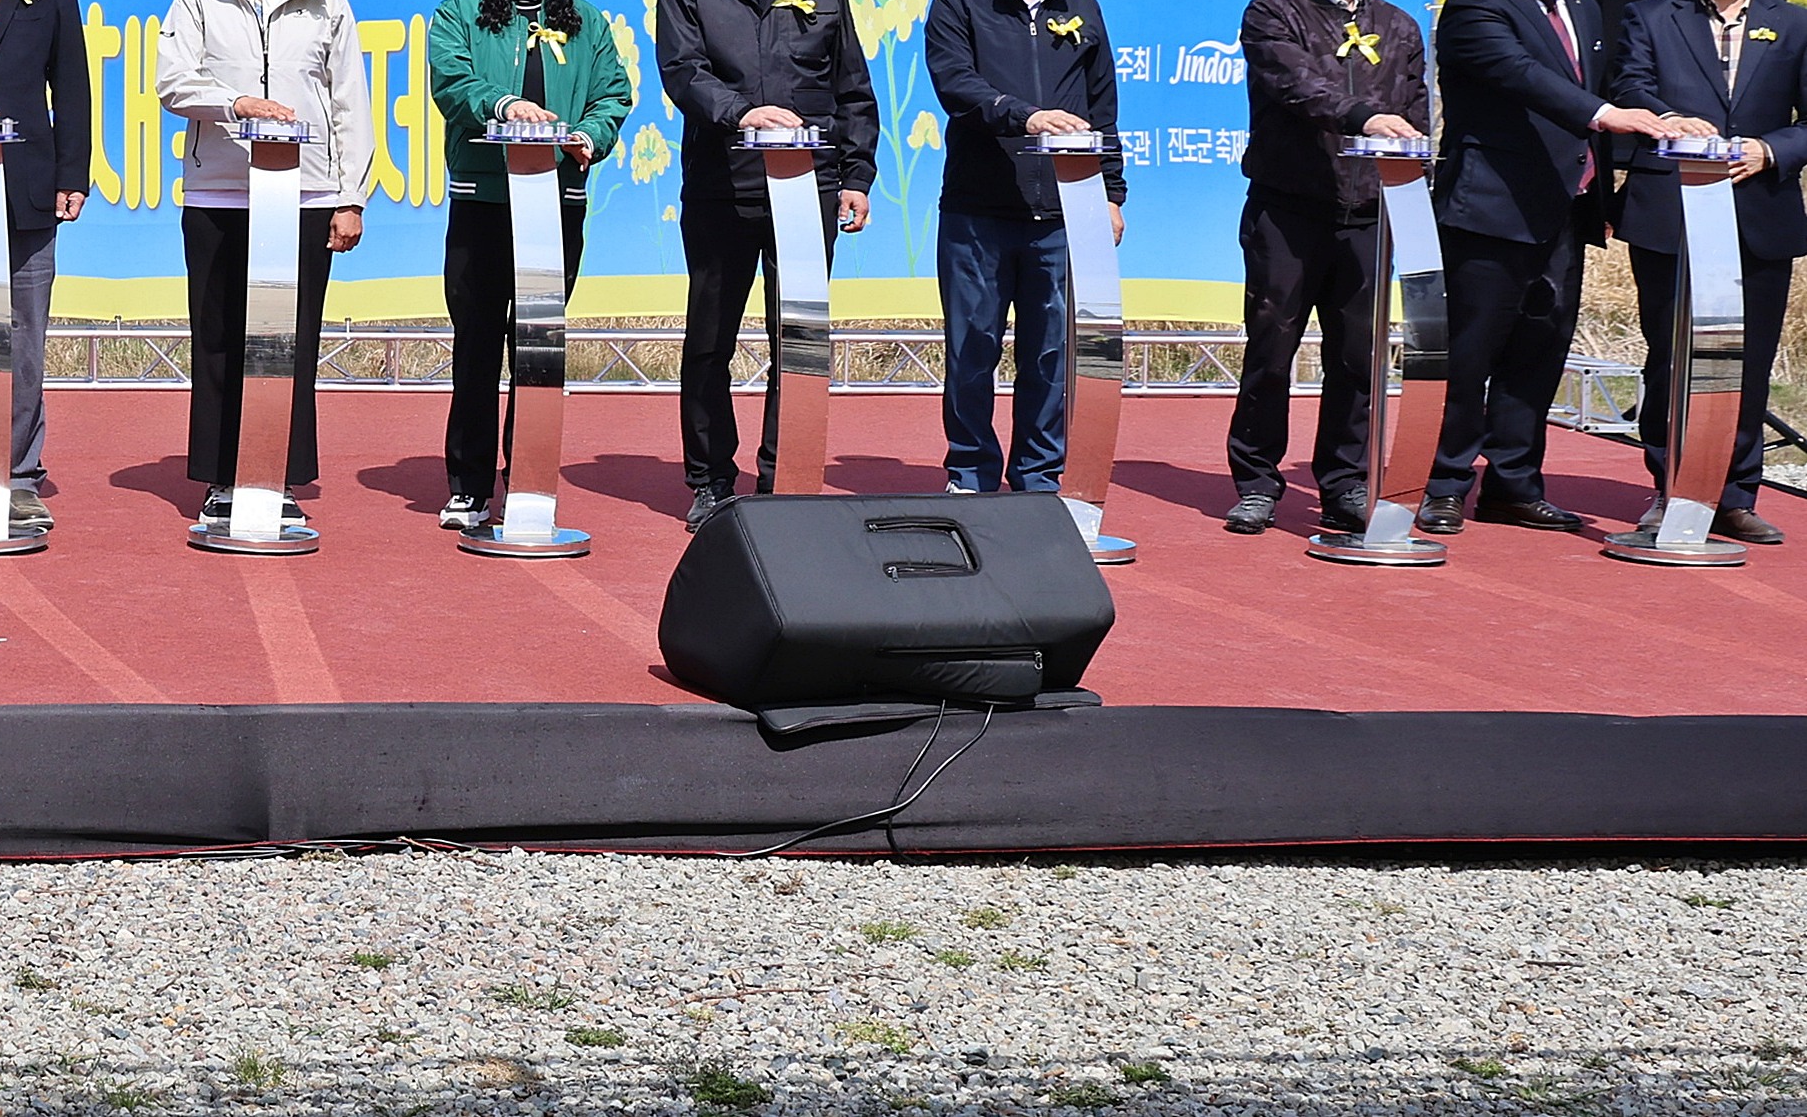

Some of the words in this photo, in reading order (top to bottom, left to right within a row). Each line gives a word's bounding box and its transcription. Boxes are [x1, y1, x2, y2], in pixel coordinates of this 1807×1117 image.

[1116, 46, 1150, 82] 주최
[1117, 131, 1151, 166] 주관
[1168, 128, 1213, 164] 진도군
[1215, 128, 1250, 165] 축제
